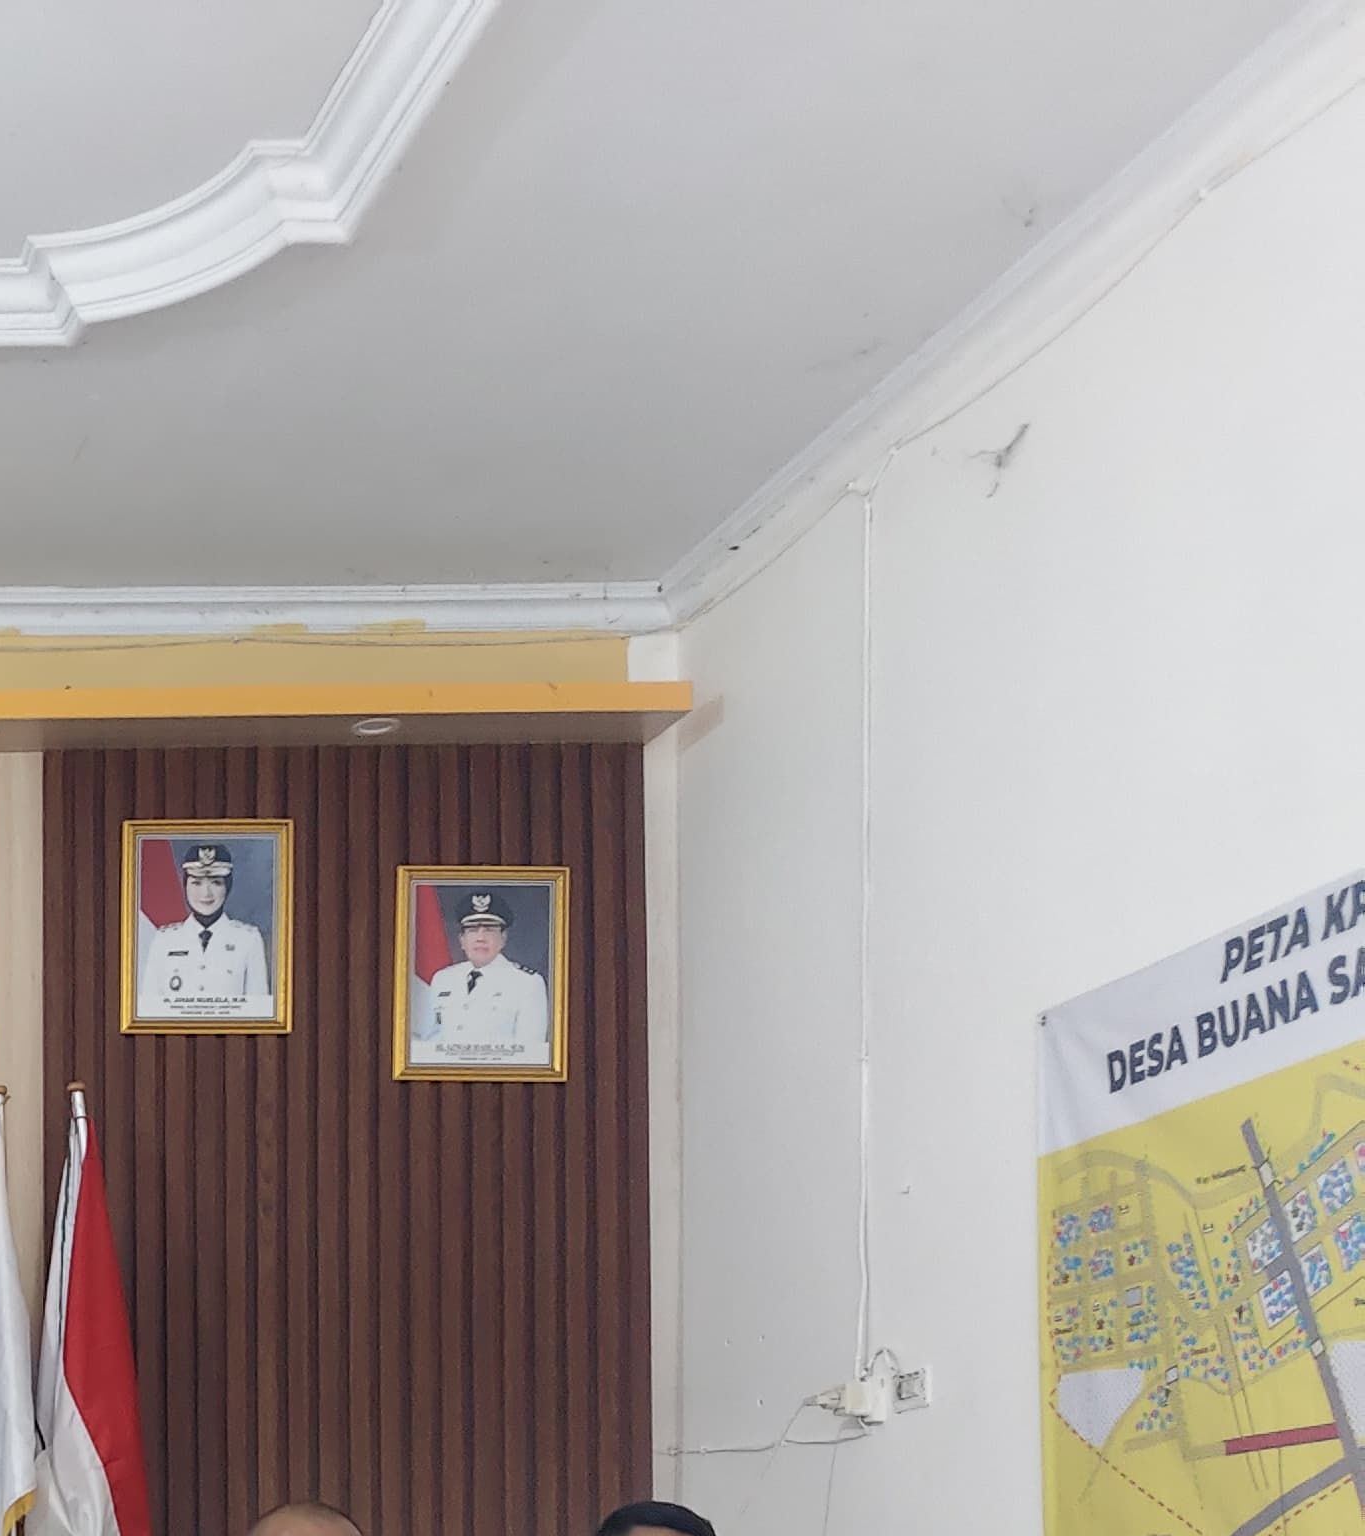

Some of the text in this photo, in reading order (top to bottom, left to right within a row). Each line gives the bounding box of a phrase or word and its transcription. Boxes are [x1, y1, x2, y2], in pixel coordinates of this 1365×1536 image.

[1219, 906, 1310, 984] PETA
[1107, 1024, 1188, 1094] DESA
[1196, 970, 1319, 1059] BUANA
